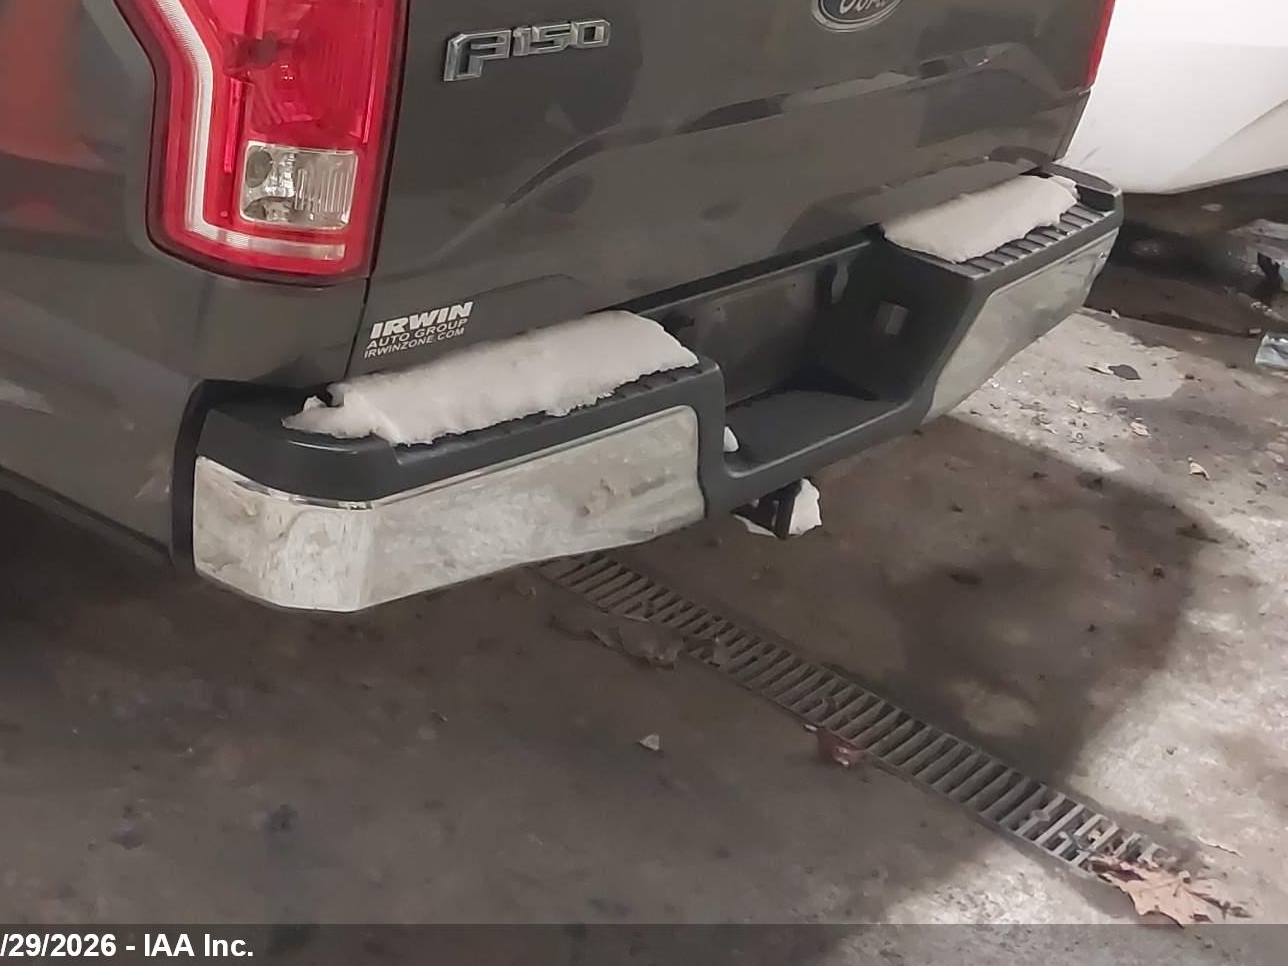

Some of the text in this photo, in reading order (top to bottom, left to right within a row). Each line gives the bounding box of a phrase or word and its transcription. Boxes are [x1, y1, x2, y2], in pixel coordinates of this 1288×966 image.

[443, 18, 611, 82] F150
[366, 318, 468, 351] AUTO GROUP
[369, 301, 474, 340] IRWIN
[363, 327, 465, 359] IRWINZONE.COM
